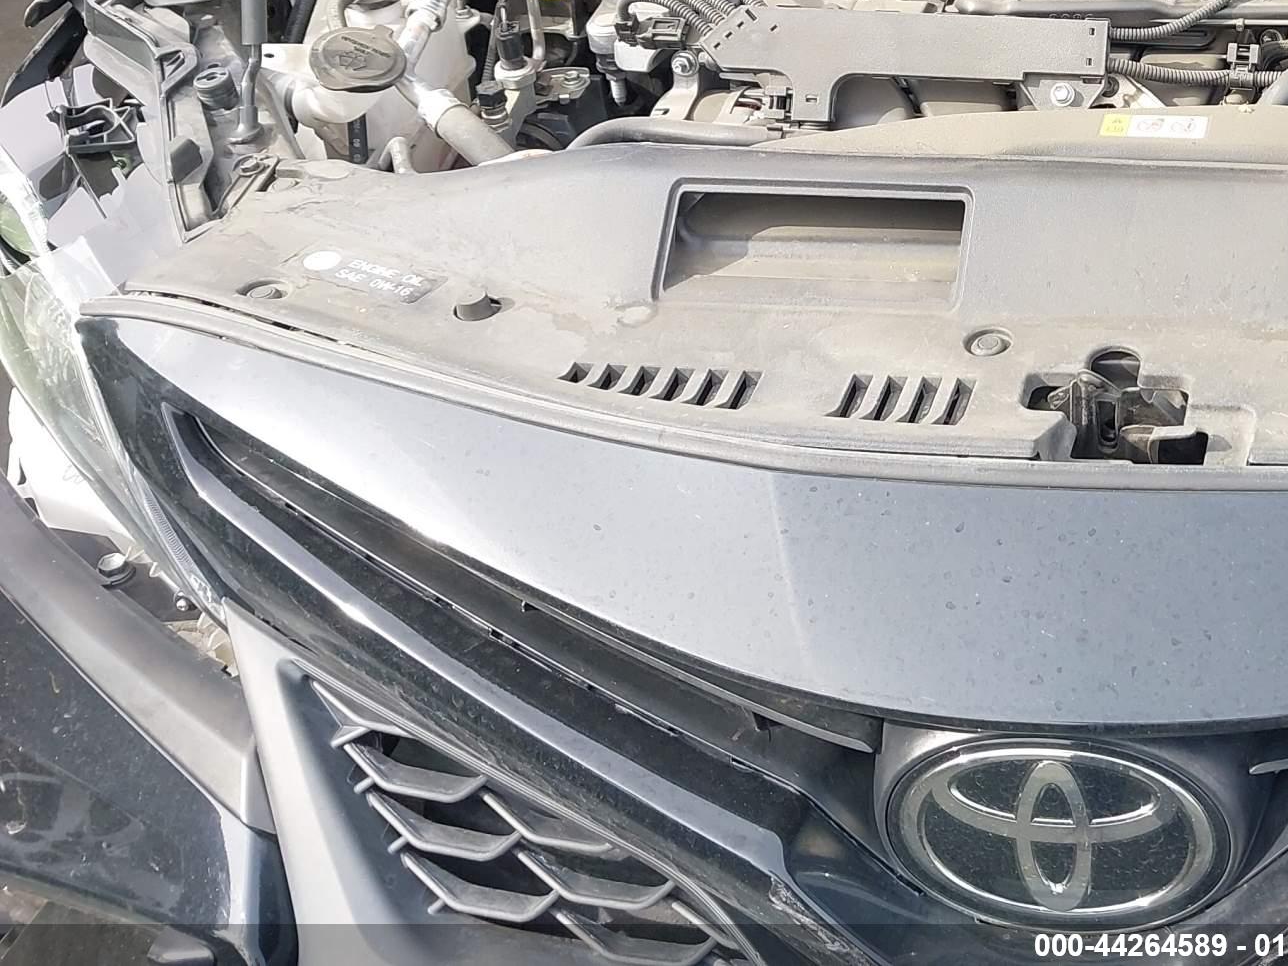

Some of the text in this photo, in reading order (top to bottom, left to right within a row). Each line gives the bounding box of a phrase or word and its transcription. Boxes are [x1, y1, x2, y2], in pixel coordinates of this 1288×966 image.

[348, 259, 400, 279] ENGINE
[335, 269, 413, 296] SAE 0W-16
